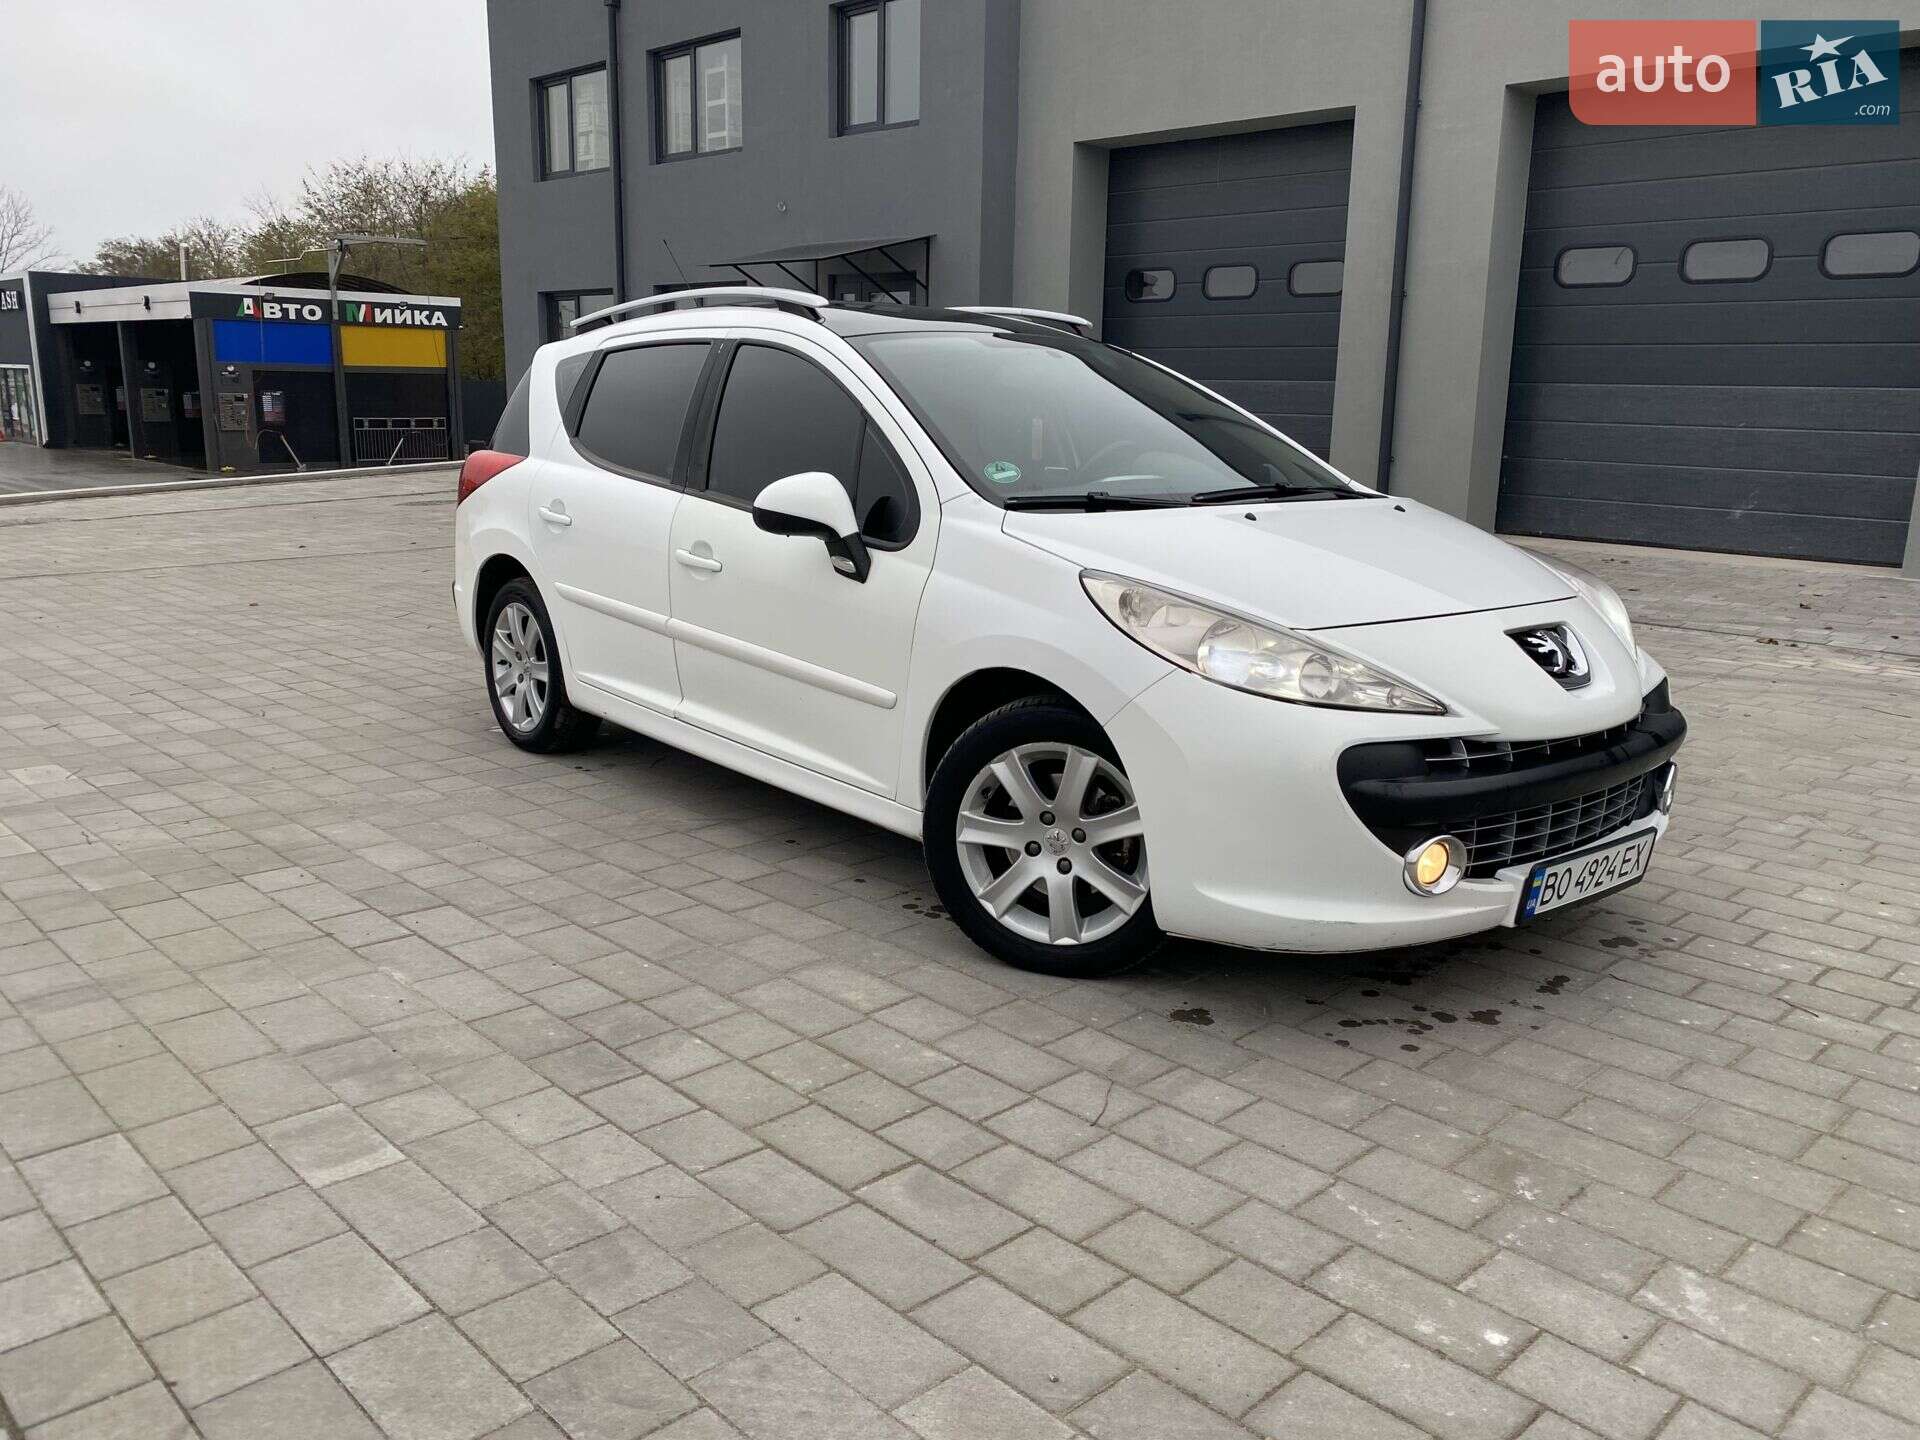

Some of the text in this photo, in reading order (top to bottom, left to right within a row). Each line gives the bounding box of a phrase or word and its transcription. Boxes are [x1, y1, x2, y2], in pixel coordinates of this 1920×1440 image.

[236, 297, 448, 326] АВТО МИЙКА
[1540, 840, 1647, 906] BO 4924 EX
